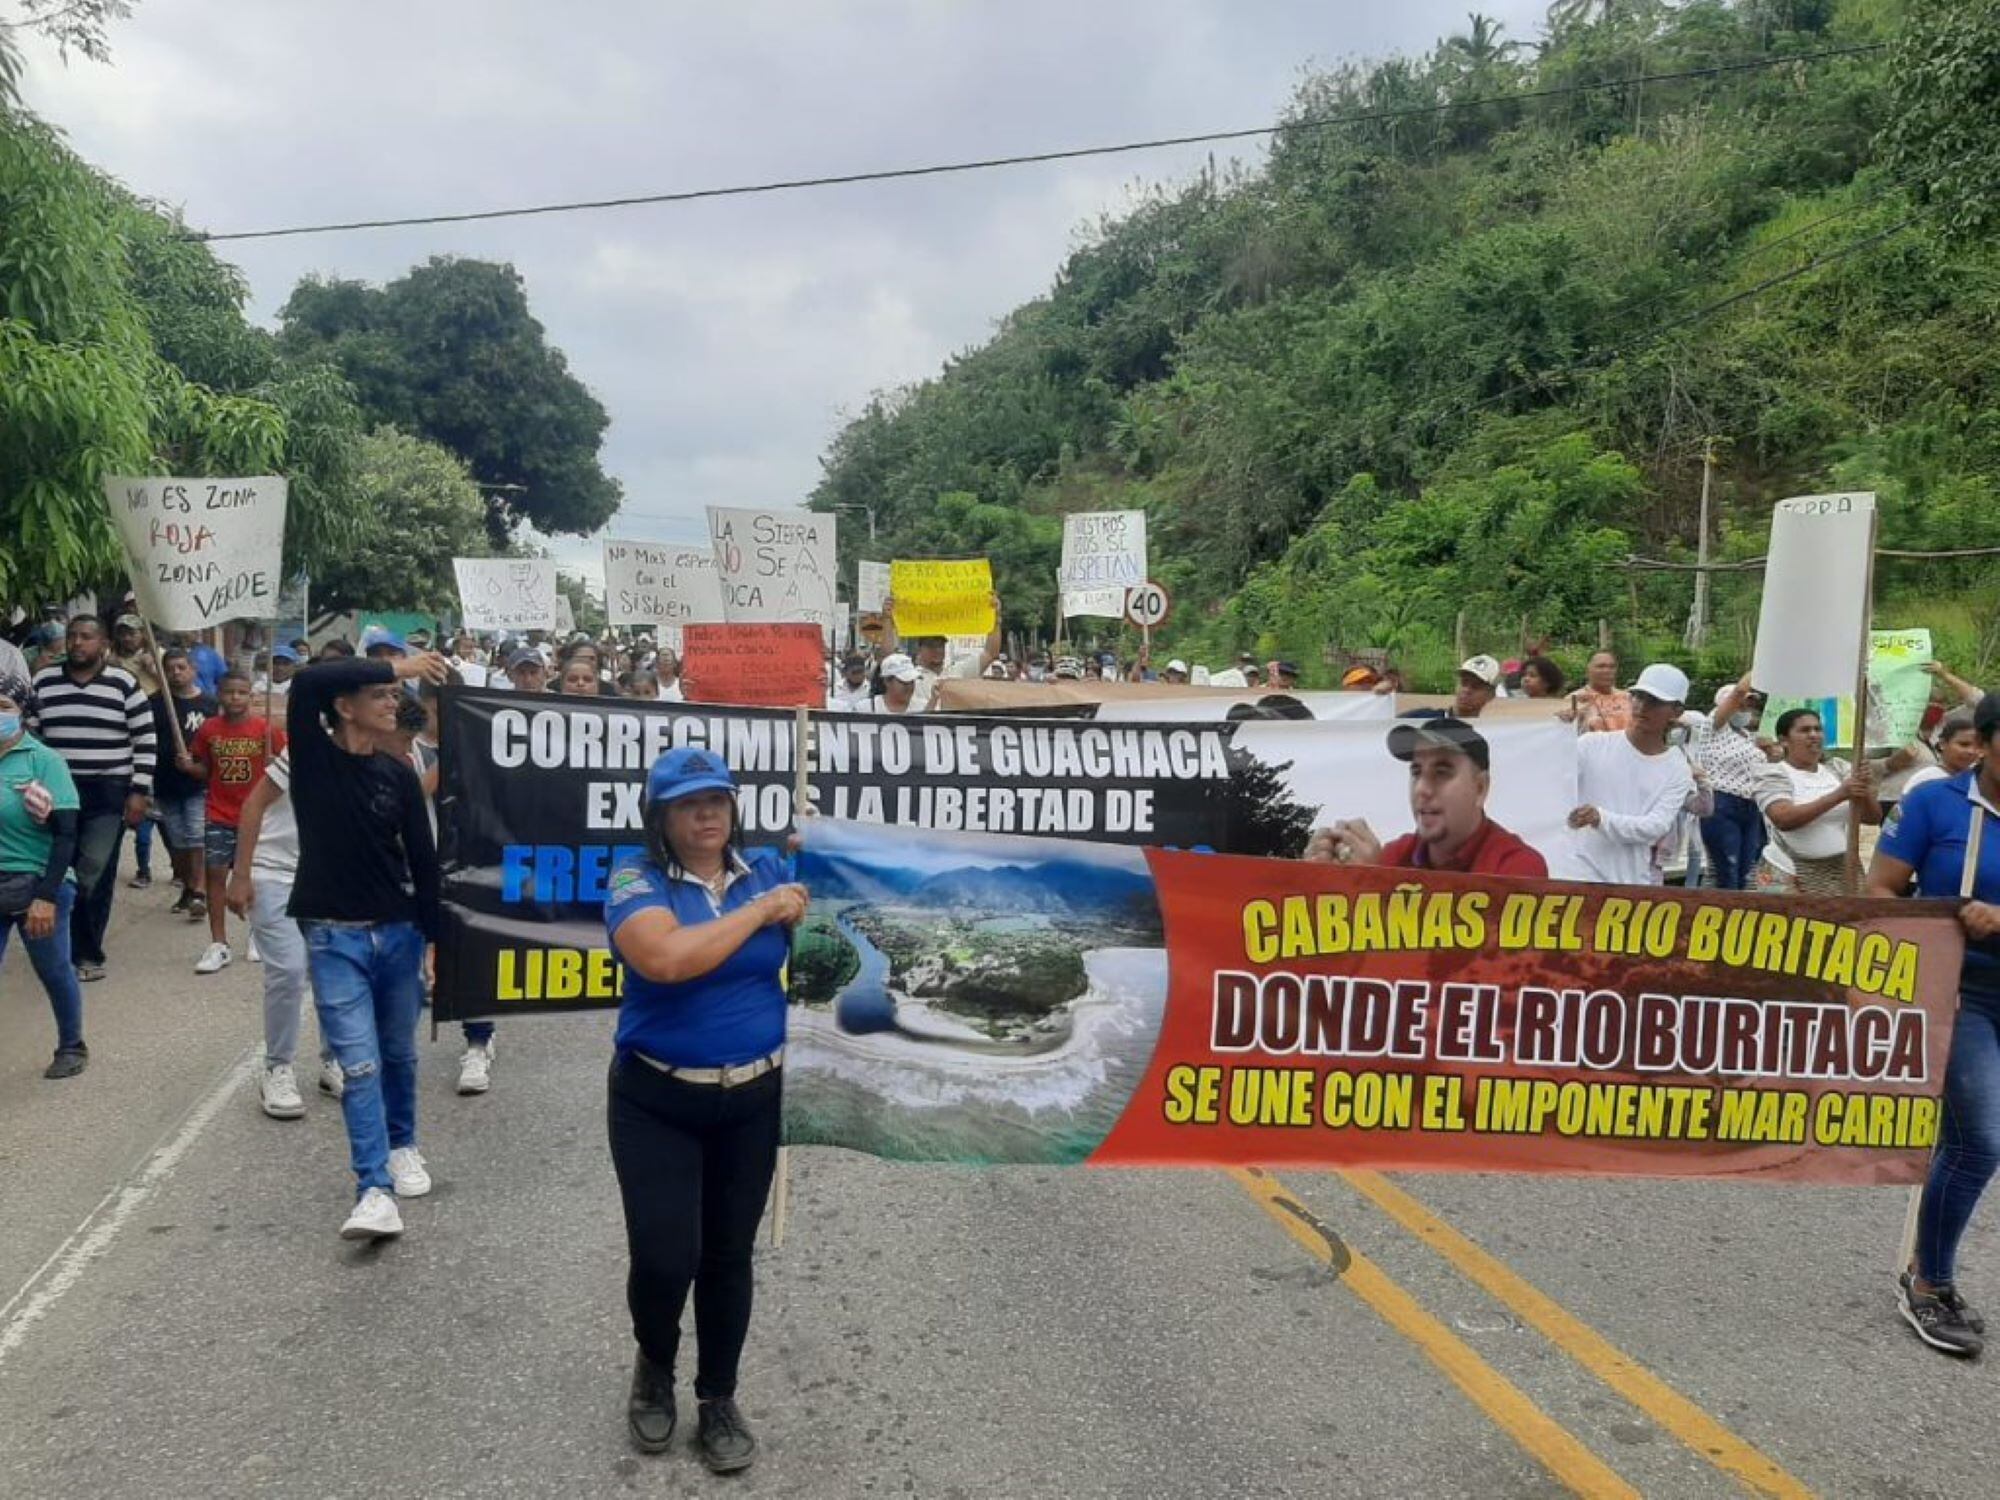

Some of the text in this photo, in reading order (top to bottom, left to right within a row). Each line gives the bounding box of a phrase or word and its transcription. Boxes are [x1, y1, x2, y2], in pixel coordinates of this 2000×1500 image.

[162, 485, 191, 513] ES
[206, 485, 257, 510] ZONA
[151, 517, 217, 554] ROJA
[715, 511, 734, 541] LA
[157, 561, 221, 584] ZONA
[756, 546, 787, 577] SE
[192, 571, 269, 619] VERDE
[1132, 592, 1161, 615] 40
[218, 757, 252, 783] 23
[924, 726, 981, 776] DE
[991, 727, 1231, 779] GUACHACA
[834, 785, 885, 824] LA
[898, 786, 1094, 833] LIBERTAD
[1105, 790, 1154, 833] DE
[1242, 883, 1920, 1003] CABAÑAS DEL RIO BURITACA
[1210, 969, 1928, 1083] DONDE EL RIO BURITACA
[1164, 1065, 1938, 1148] SE UNE CON EL IMPONENTE MAR CARIB
